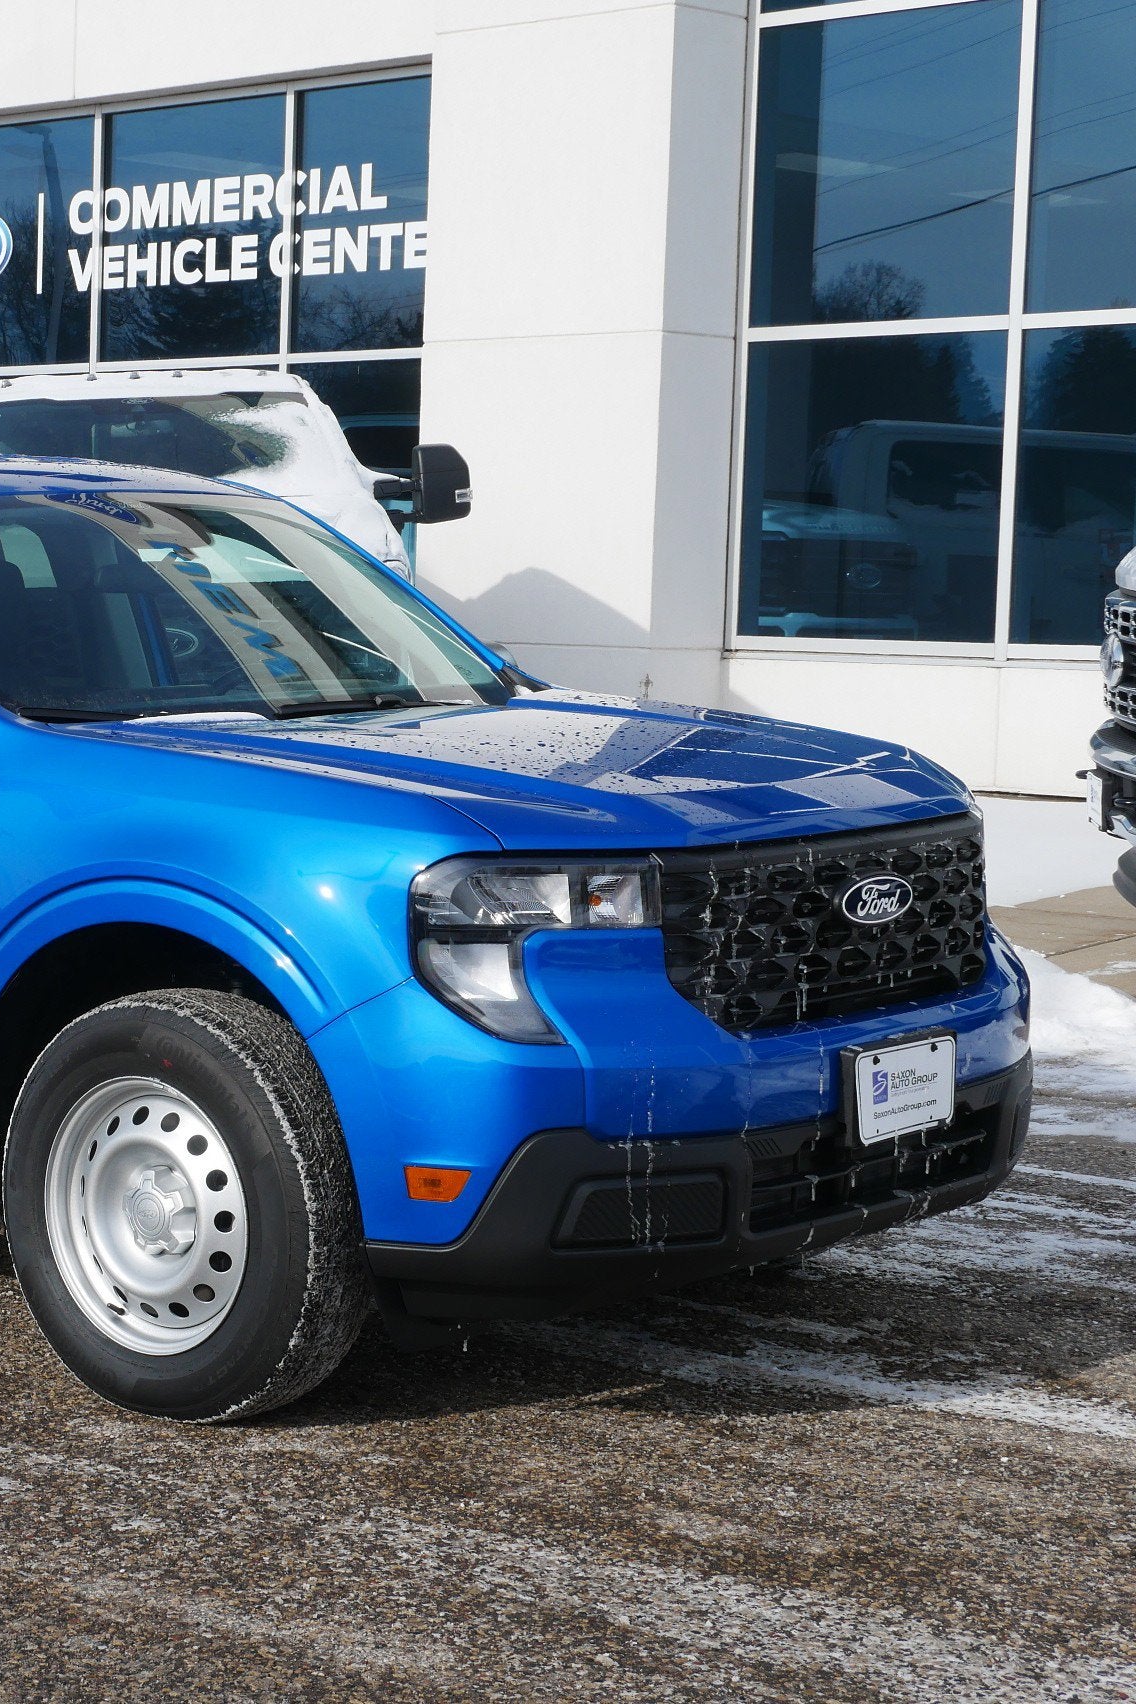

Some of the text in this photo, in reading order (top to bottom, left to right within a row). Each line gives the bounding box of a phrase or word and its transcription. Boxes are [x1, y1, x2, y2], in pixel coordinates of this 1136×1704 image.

[69, 164, 387, 234] COMMERCIAL
[68, 234, 258, 291] VEHICLE
[857, 883, 901, 917] Ford
[890, 1068, 916, 1081] SAXON
[890, 1072, 938, 1091] AUTO GROUP
[873, 1099, 937, 1120] SaxonAutoGroup.com
